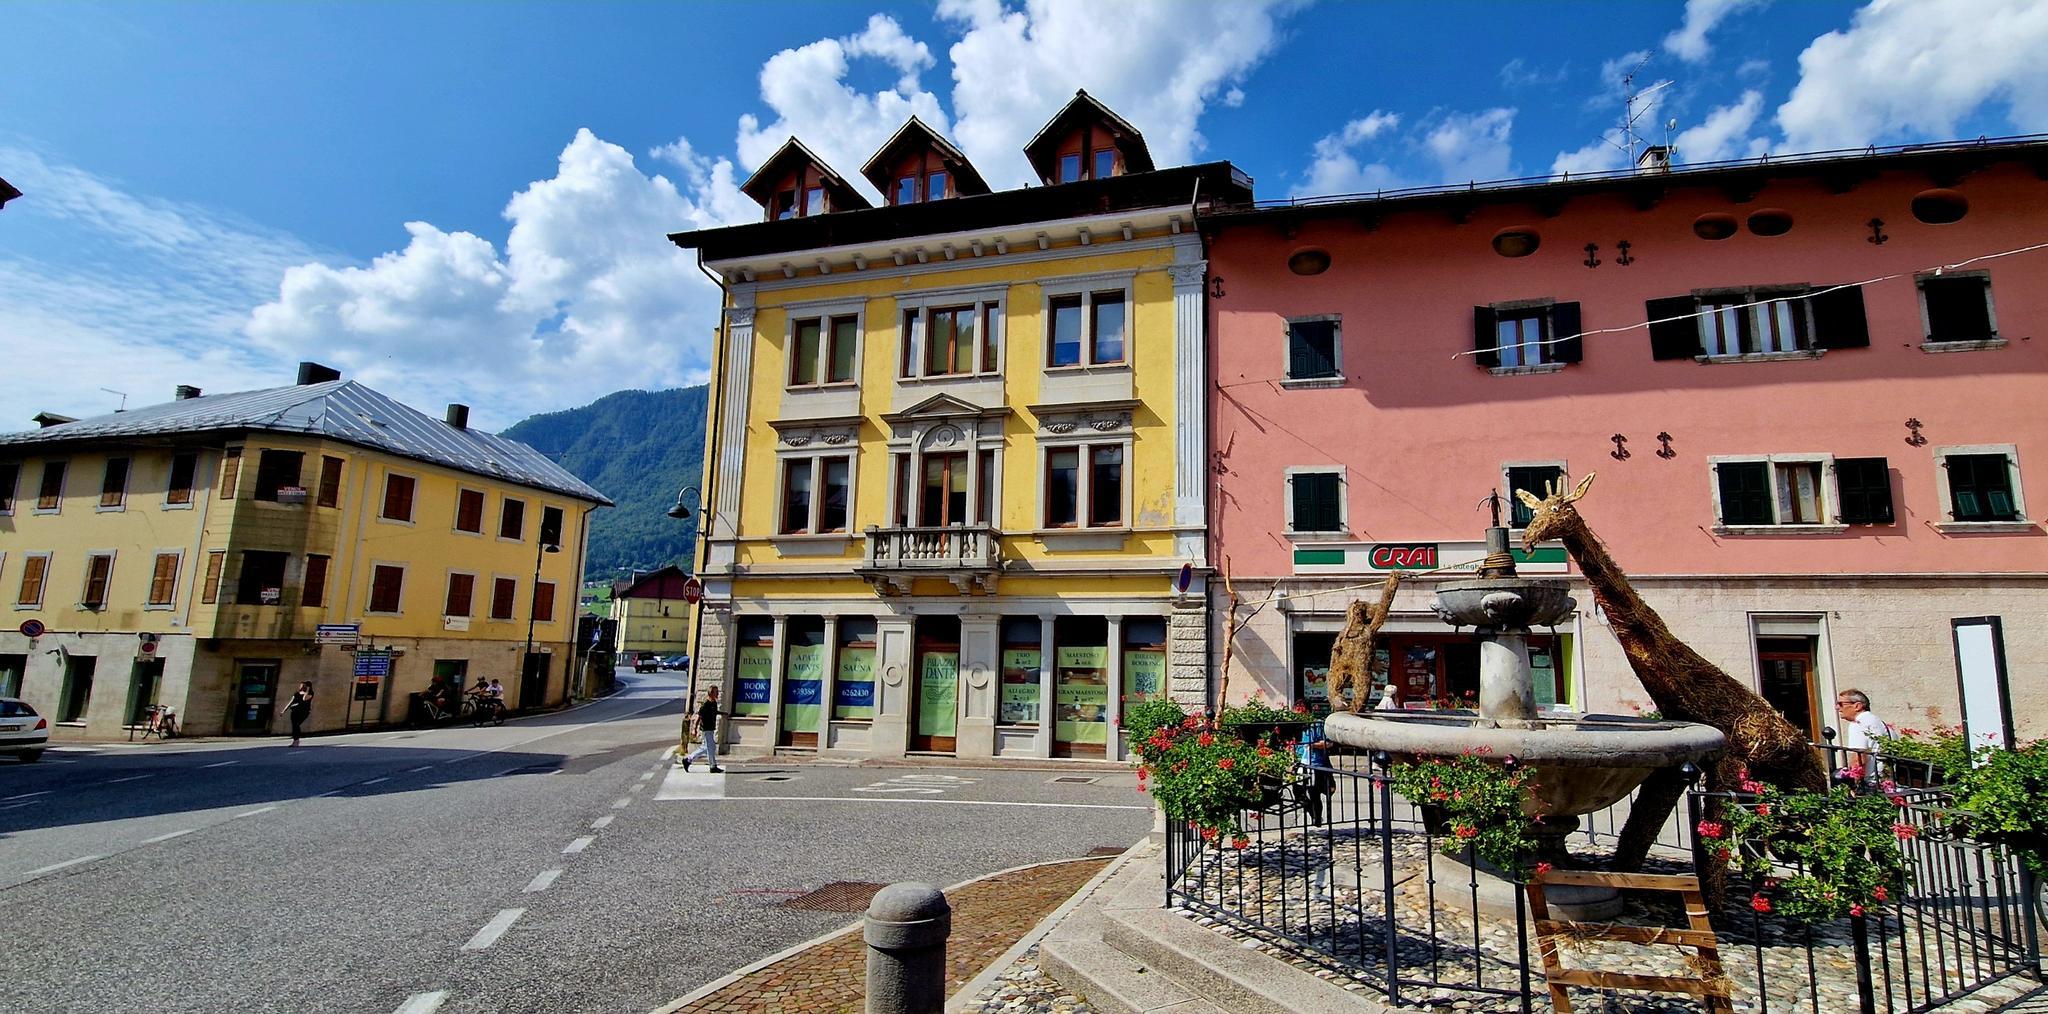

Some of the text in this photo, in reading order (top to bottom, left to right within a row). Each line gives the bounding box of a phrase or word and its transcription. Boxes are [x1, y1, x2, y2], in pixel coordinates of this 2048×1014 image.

[1373, 547, 1435, 567] CRAI
[685, 586, 700, 597] STOP
[743, 657, 773, 666] BEAUTY
[793, 663, 820, 672] MENTS
[843, 664, 872, 672] SAUNA
[925, 667, 956, 679] DANTE
[744, 682, 767, 691] BOOK
[745, 692, 765, 700] NOW
